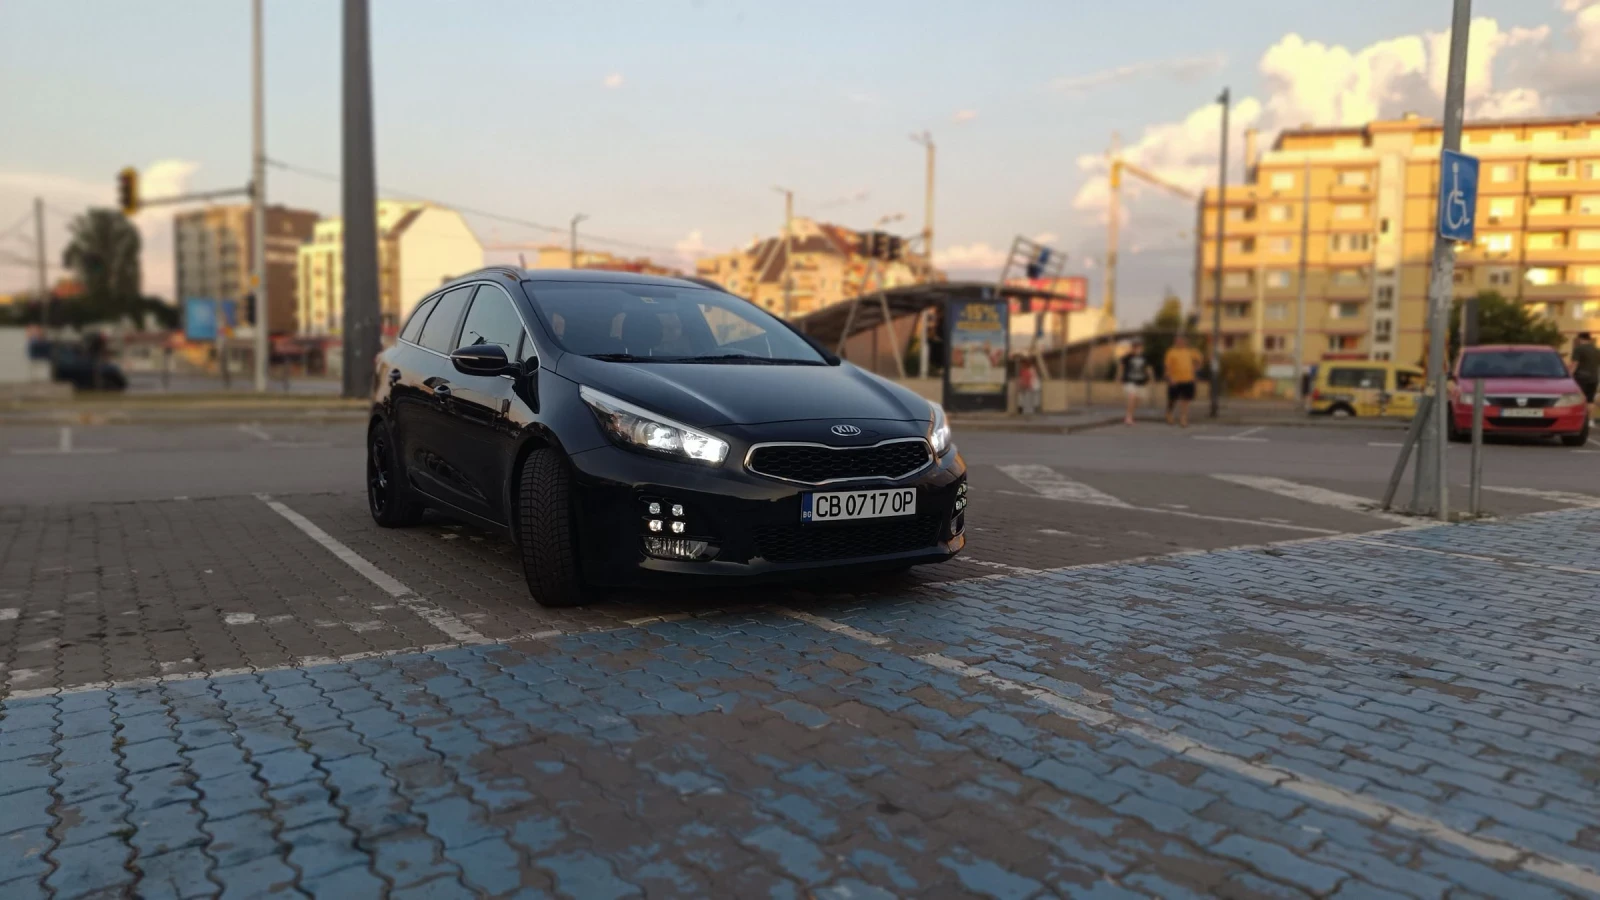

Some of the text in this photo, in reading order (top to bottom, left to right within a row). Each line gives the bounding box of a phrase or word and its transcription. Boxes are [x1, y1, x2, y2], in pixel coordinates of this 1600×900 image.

[836, 424, 859, 434] KIA
[816, 496, 841, 517] CB
[845, 492, 889, 515] 0717
